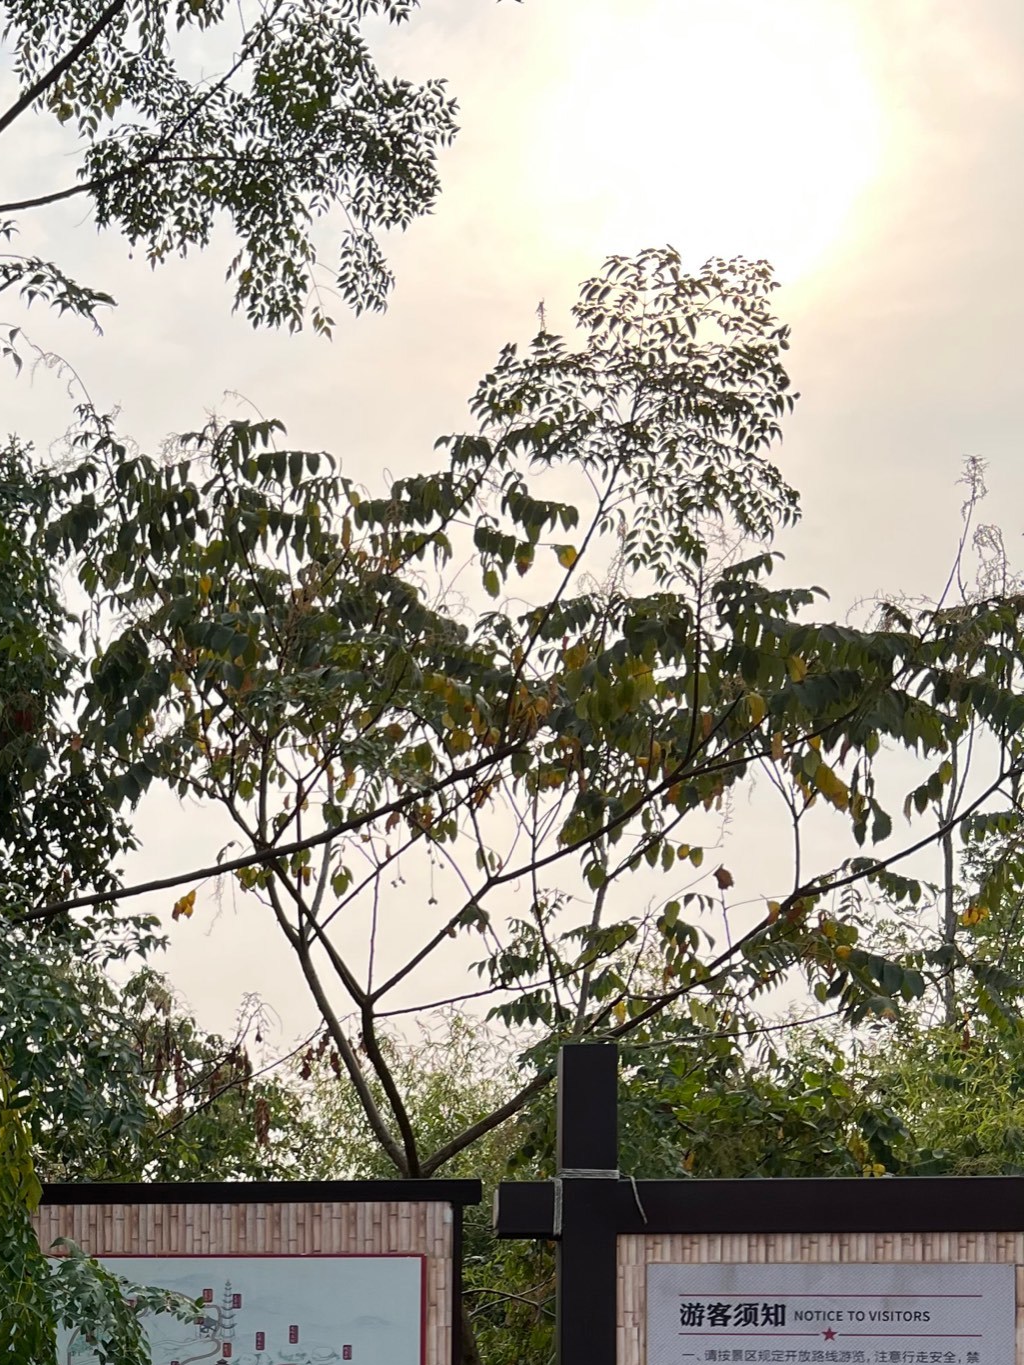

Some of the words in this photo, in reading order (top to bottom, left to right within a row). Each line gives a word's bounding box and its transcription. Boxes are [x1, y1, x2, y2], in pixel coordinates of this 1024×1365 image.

[679, 1302, 786, 1327] 游客须知
[794, 1310, 842, 1321] NOTICE
[847, 1310, 865, 1321] TO
[868, 1310, 930, 1321] VISITORS
